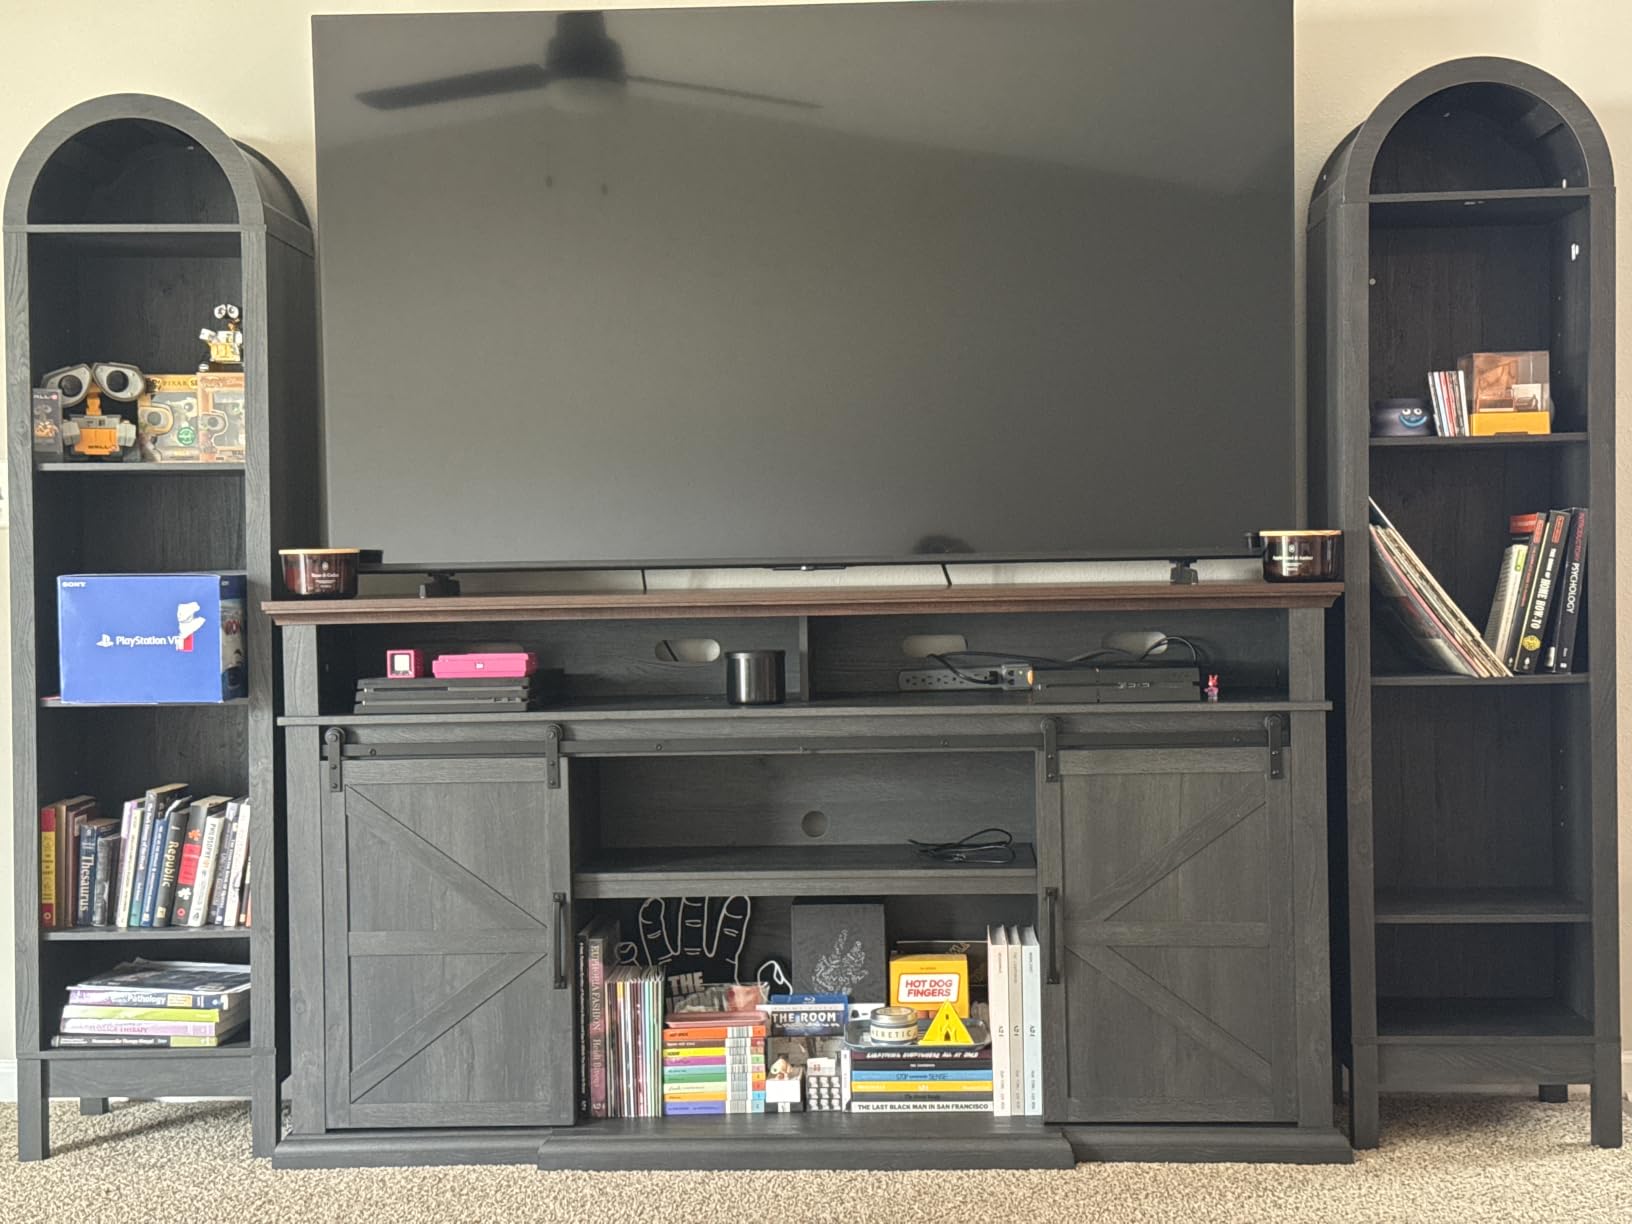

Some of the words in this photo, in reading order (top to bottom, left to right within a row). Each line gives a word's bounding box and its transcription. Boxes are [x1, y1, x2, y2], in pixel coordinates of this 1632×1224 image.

[1536, 578, 1550, 600] HOME
[1566, 562, 1580, 614] PSYCHOLOGY
[116, 636, 166, 647] PlayStation
[162, 841, 180, 888] Republic
[80, 853, 94, 912] Thesaurus
[591, 945, 600, 992] EUPHORIA
[667, 972, 704, 996] THE
[905, 980, 928, 988] HOT
[929, 980, 952, 988] DOG
[907, 988, 951, 997] FINGERS
[127, 994, 166, 1004] Pathology
[591, 992, 601, 1032] FASHION
[772, 1012, 795, 1023] THE
[801, 1012, 836, 1022] ROOM
